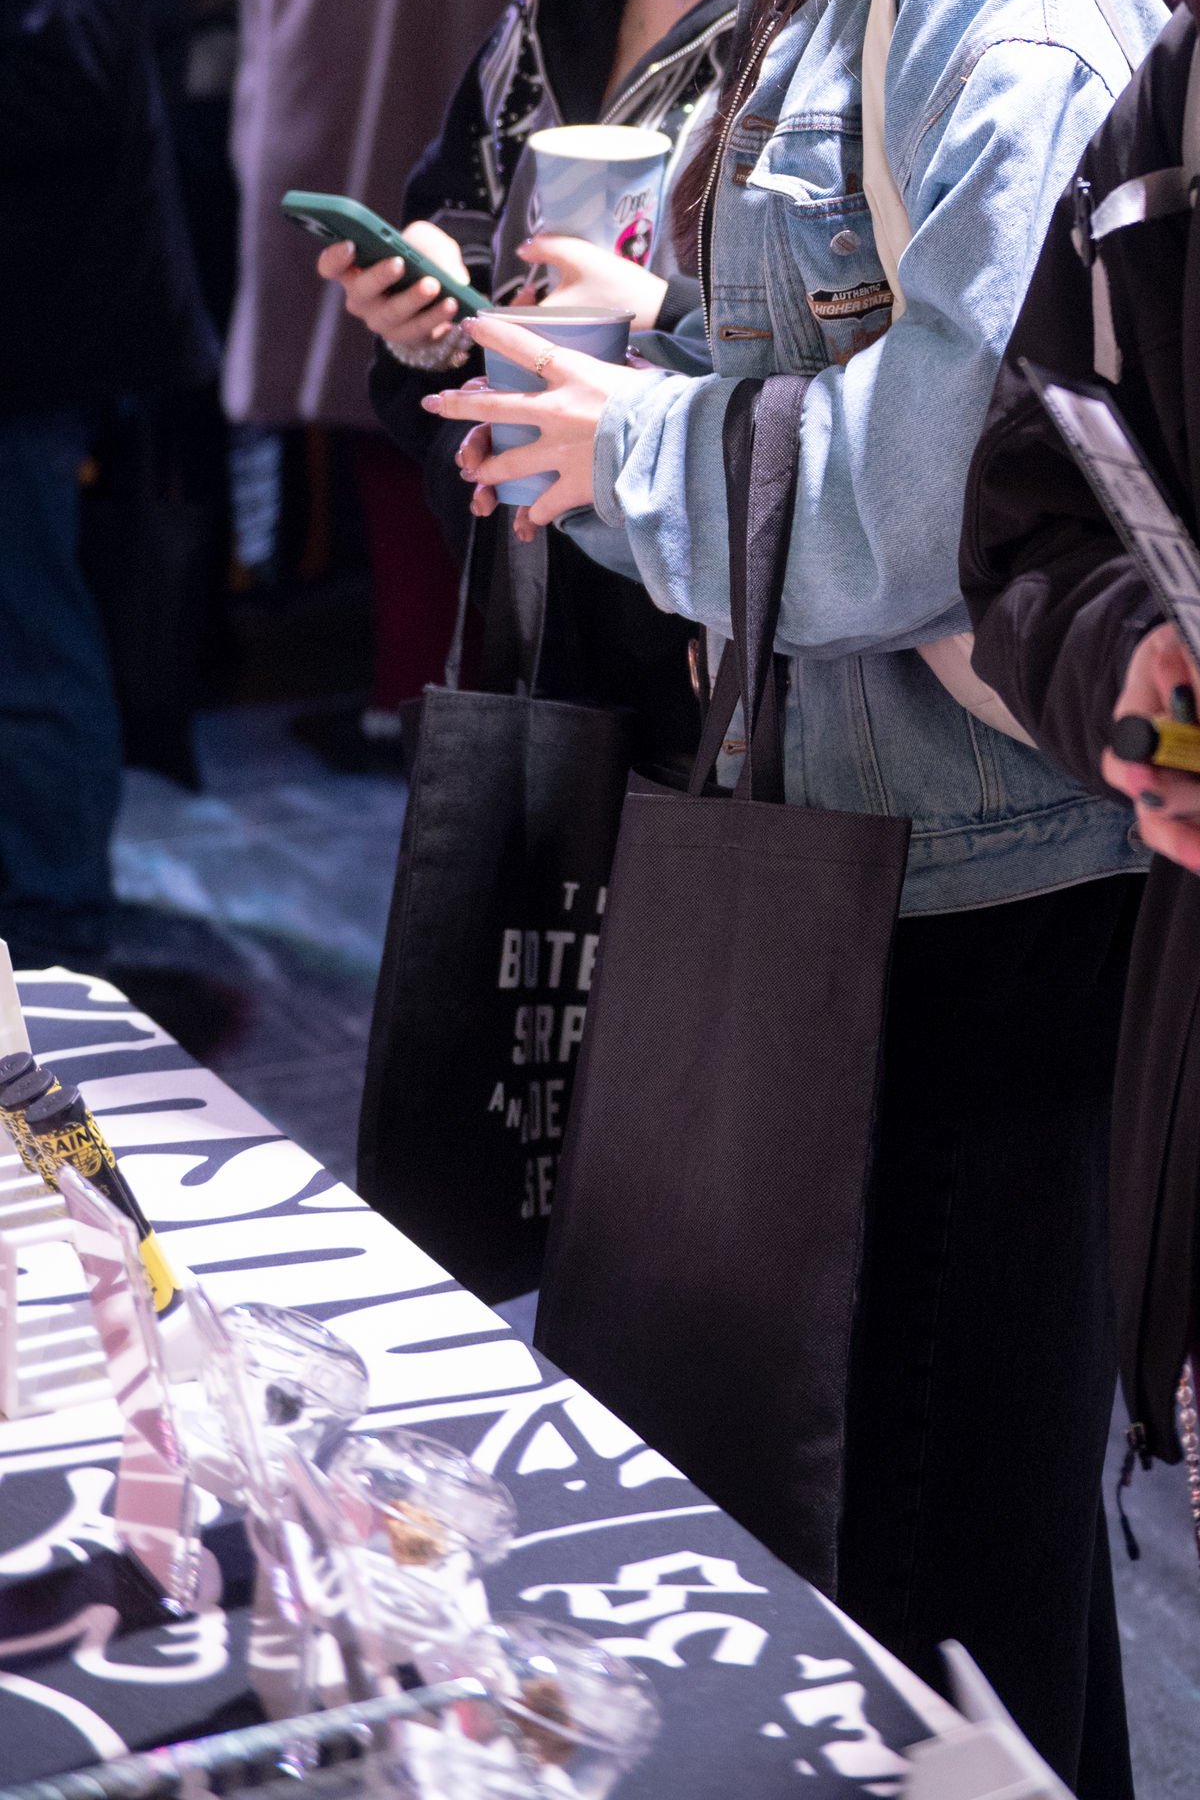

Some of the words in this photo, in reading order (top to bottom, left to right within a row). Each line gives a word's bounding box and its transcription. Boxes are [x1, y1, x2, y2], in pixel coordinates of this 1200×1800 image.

[832, 283, 881, 302] AUTHENTIC
[815, 302, 861, 315] HIGHER
[862, 292, 892, 308] STATE
